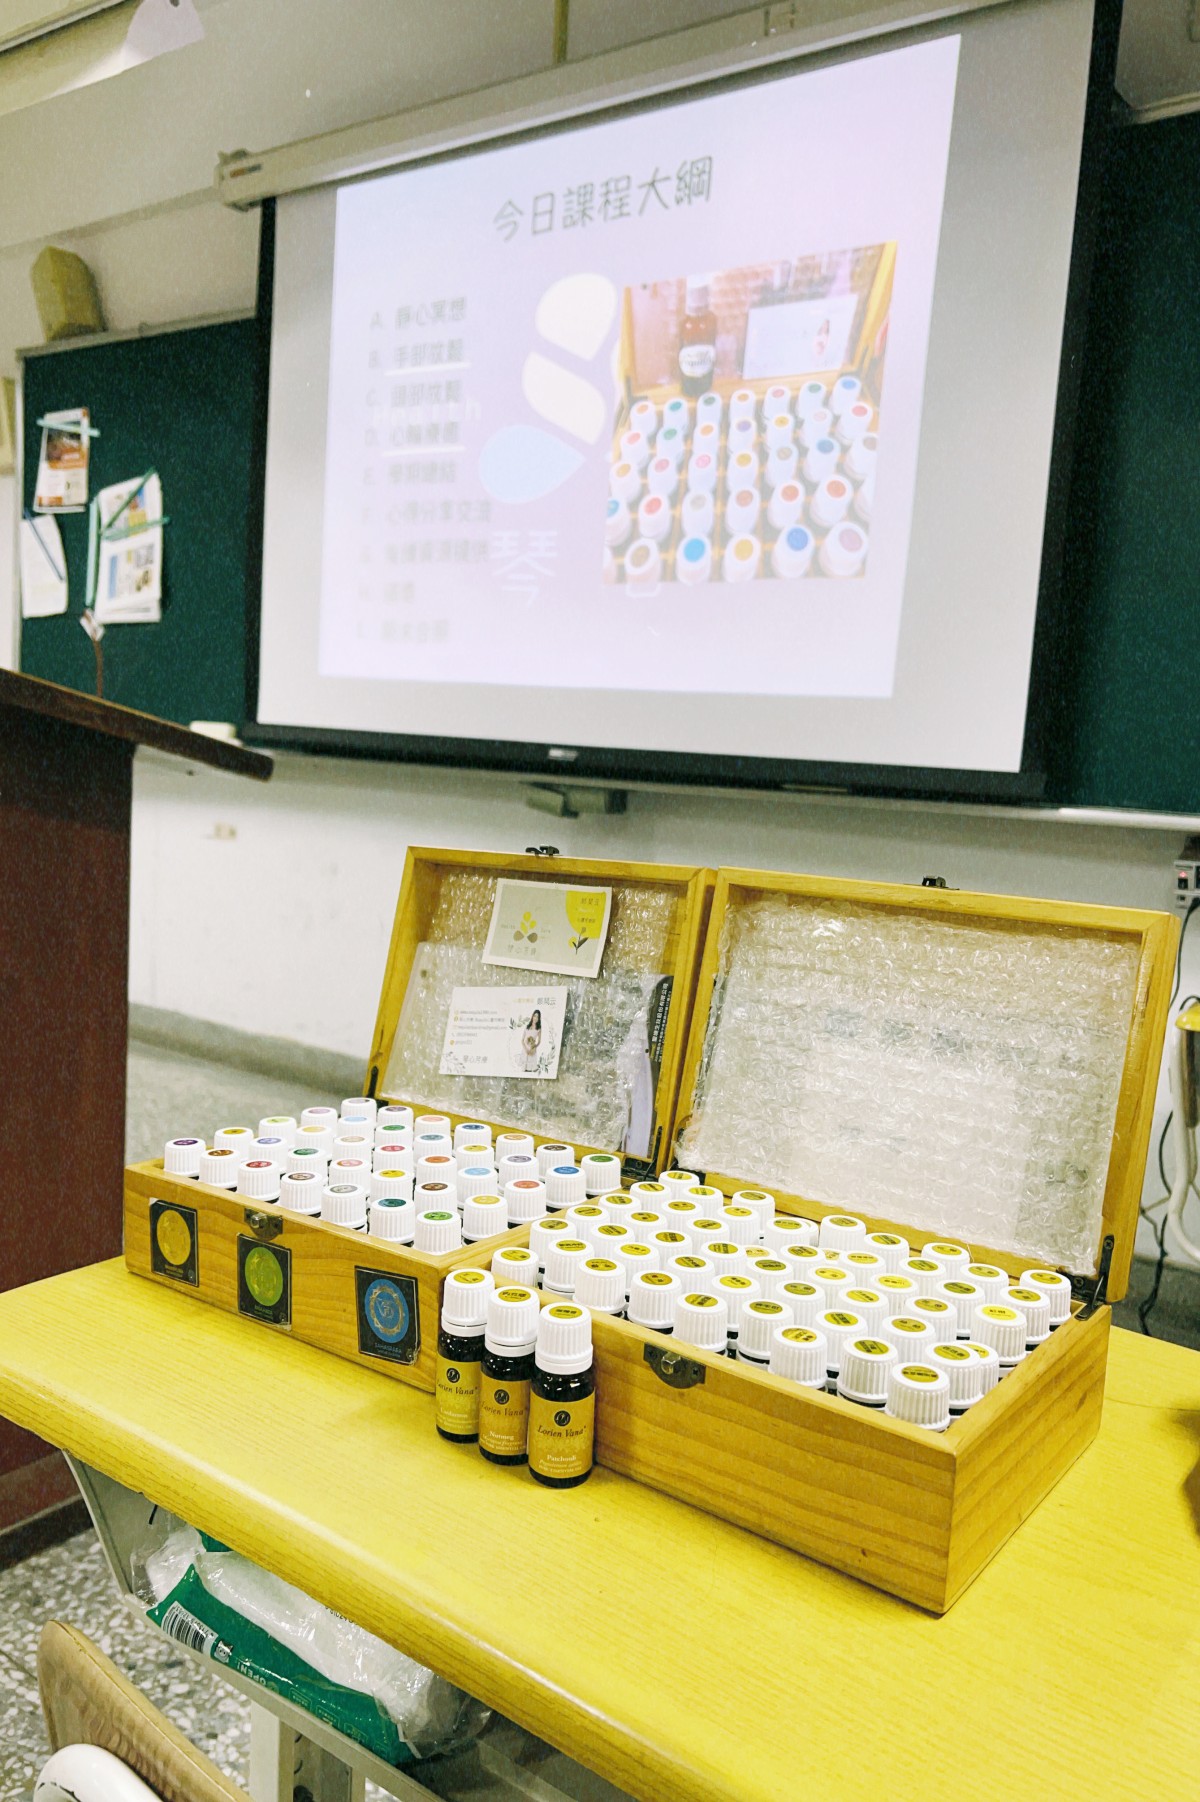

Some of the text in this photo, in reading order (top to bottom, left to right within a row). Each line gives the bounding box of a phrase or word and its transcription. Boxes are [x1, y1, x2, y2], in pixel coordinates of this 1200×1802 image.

[492, 155, 713, 242] 今日課程大綱
[490, 529, 559, 608] 琴
[537, 1424, 584, 1438] Lorien Vana
